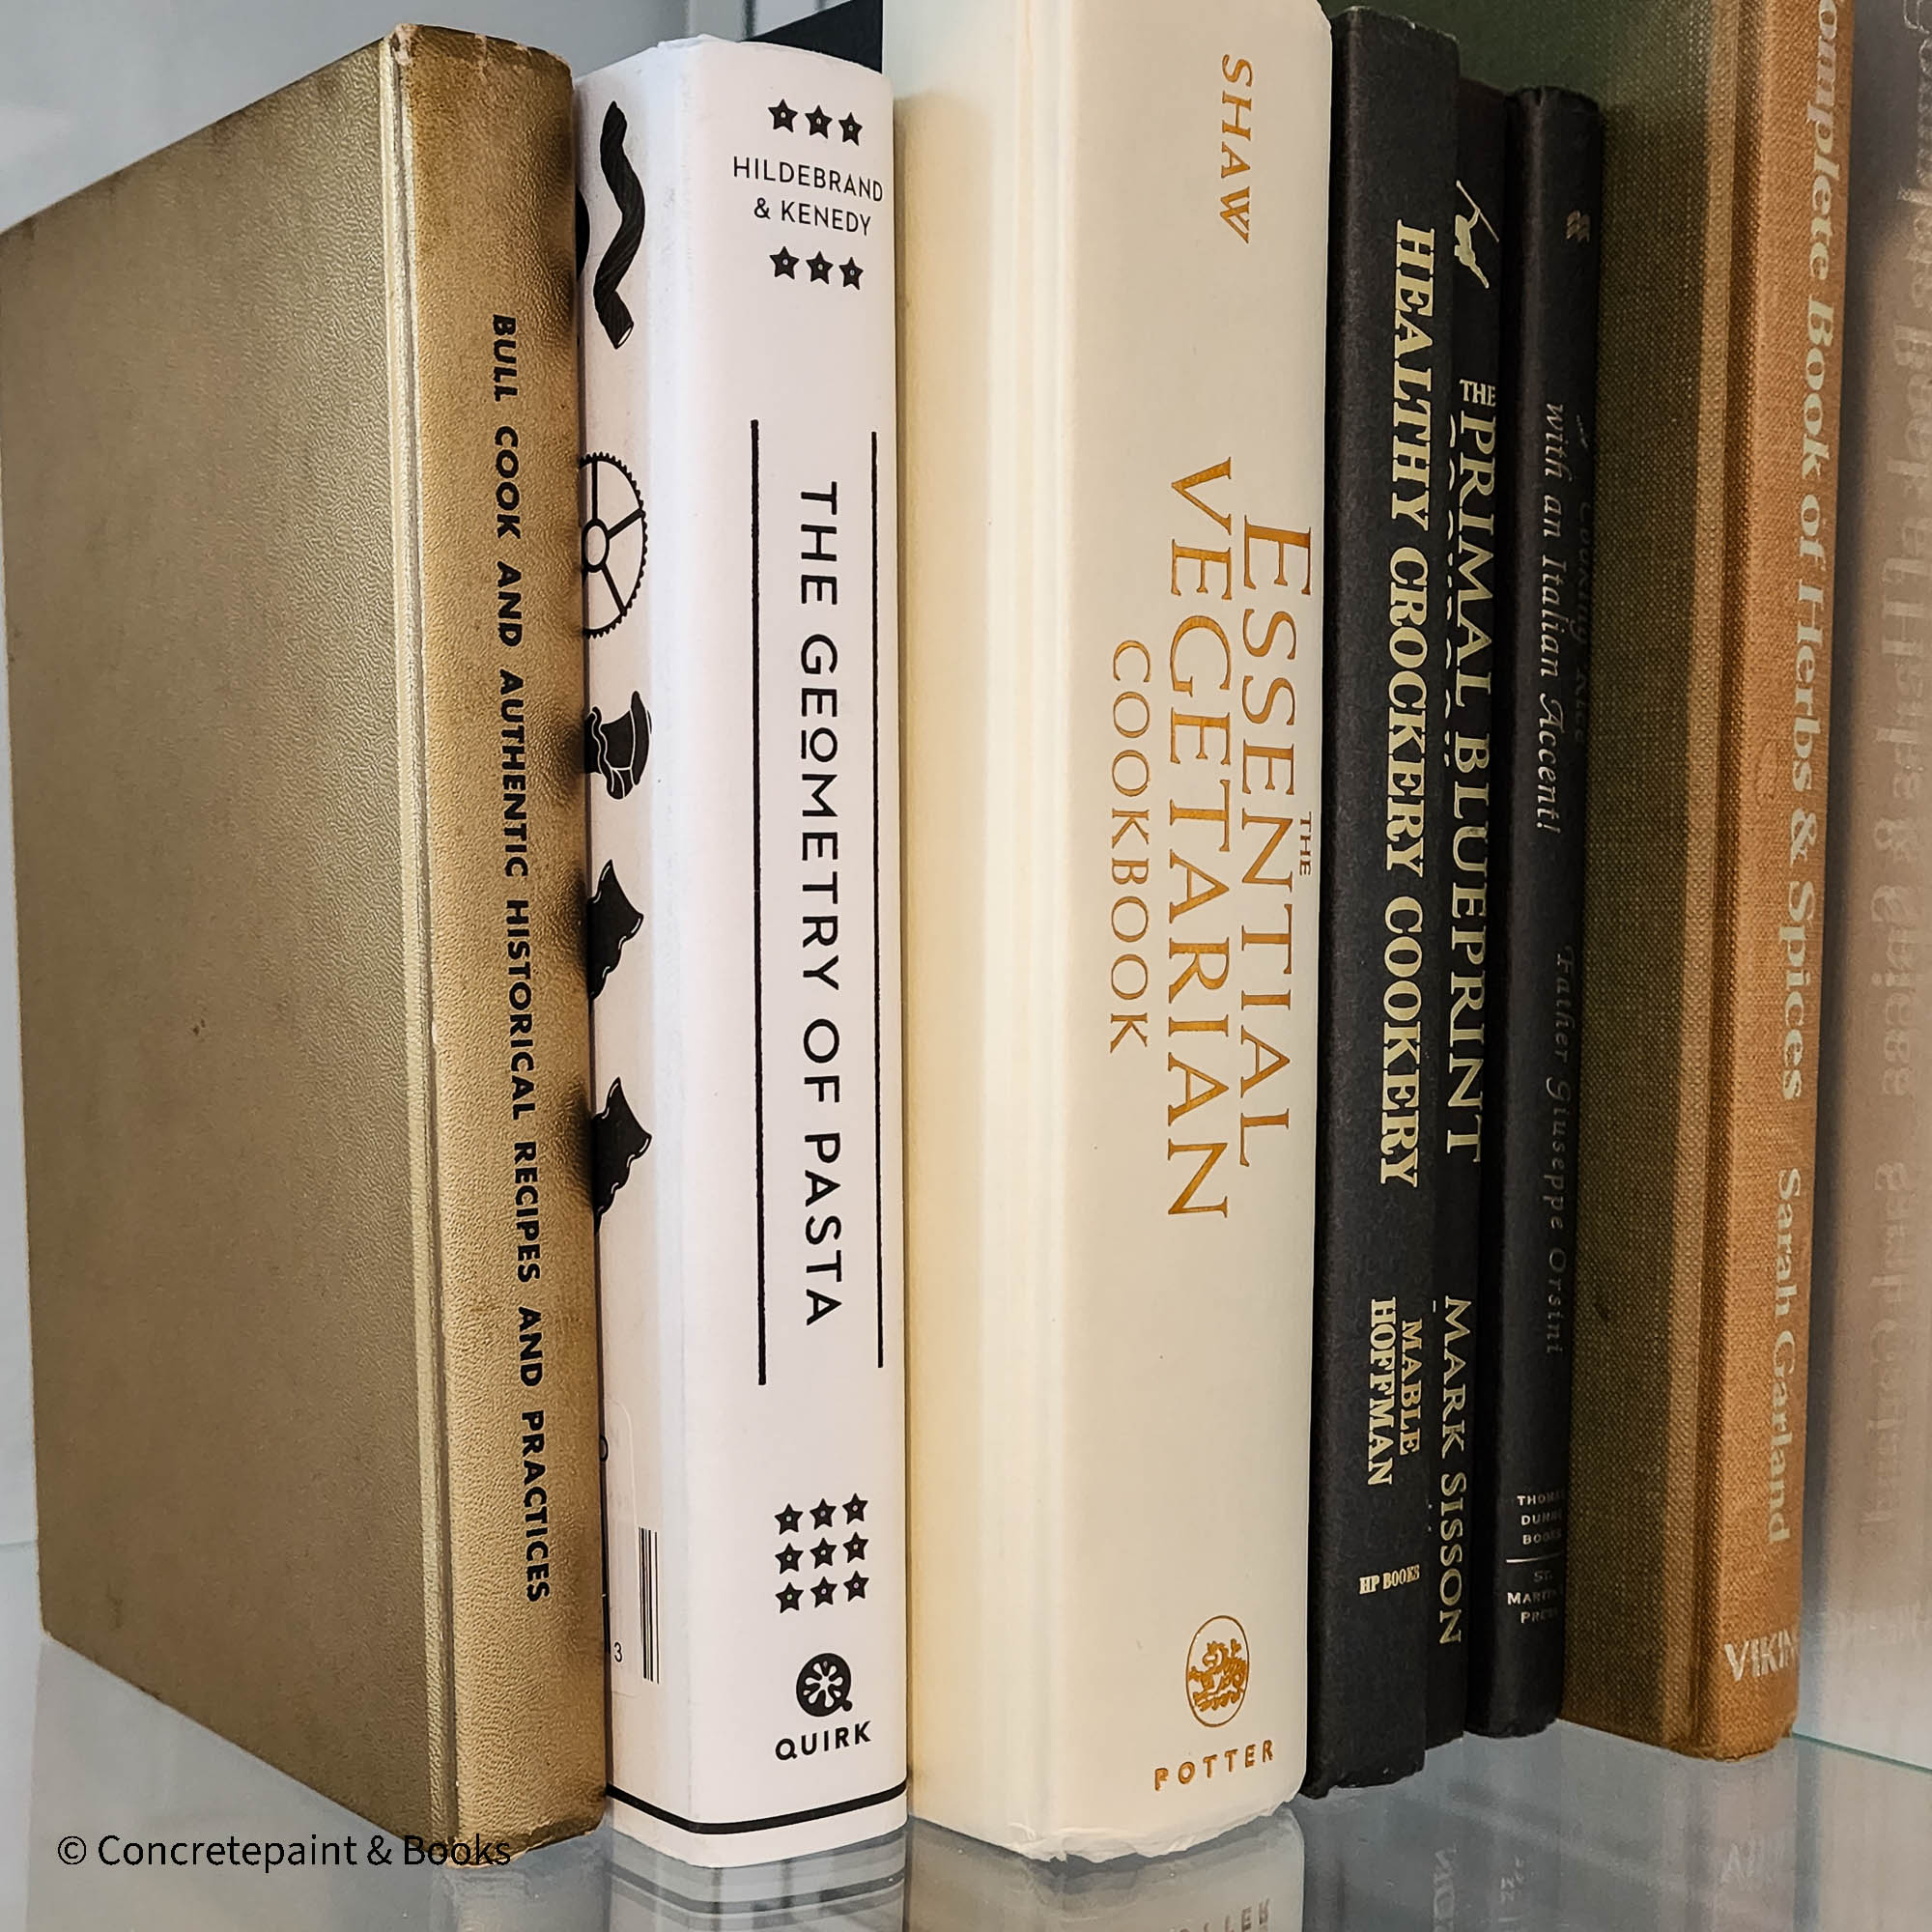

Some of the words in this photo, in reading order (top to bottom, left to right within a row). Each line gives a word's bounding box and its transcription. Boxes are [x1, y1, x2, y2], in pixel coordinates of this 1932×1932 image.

[732, 156, 884, 202] HILDEBRAND
[1220, 54, 1253, 242] SHAW
[1807, 0, 1840, 280] omplete
[753, 196, 771, 220] &
[781, 199, 871, 237] KENEDY
[492, 313, 519, 402] BULL
[1391, 218, 1435, 531] HEALTHY
[1459, 379, 1496, 407] THE
[1802, 298, 1833, 476] Book
[494, 425, 522, 540] COOK
[1545, 402, 1573, 482] with
[800, 480, 838, 606] THE
[1455, 410, 1496, 707] PRIMAL
[1543, 495, 1562, 537] an
[1799, 493, 1827, 572] of
[497, 560, 523, 647] AND
[1540, 554, 1567, 678] Italian
[1386, 547, 1429, 878] CROCKERY
[1792, 582, 1825, 792] Herbs
[498, 668, 528, 877] AUTHENTIC
[800, 633, 839, 991] GEOMETRY
[1536, 693, 1564, 834] Accent!
[1110, 639, 1151, 1054] COOKBOOK
[1166, 458, 1233, 1215] VEGETARIAN
[1239, 514, 1313, 1168] ESSENTIAL
[1299, 810, 1312, 876] THE
[1789, 808, 1817, 864] &
[505, 897, 536, 1121] HISTORICAL
[1447, 730, 1491, 1163] BLUEPRINT
[1553, 945, 1576, 1063] Father
[1779, 881, 1813, 1098] Spices
[803, 1018, 840, 1103] OF
[1379, 895, 1424, 1188] COOKERY
[514, 1141, 541, 1283] RECIPES
[1543, 1076, 1573, 1231] Giuseppe
[804, 1132, 842, 1326] PASTA
[1776, 1167, 1802, 1315] Sarah
[518, 1306, 544, 1387] AND
[1546, 1247, 1567, 1354] Orsini
[1367, 1296, 1397, 1486] HOFFMAN
[1399, 1319, 1423, 1456] MABLE
[1441, 1295, 1472, 1459] MARK
[1769, 1329, 1794, 1540] Garland
[521, 1409, 551, 1604] PRACTICES
[1439, 1473, 1466, 1644] SISSON
[1359, 1575, 1380, 1595] HP
[1382, 1564, 1420, 1590] BOOKS
[613, 1641, 623, 1663] 3
[1723, 1630, 1797, 1682] VIKIN
[775, 1720, 871, 1761] QUIRK
[1154, 1740, 1273, 1792] POTTER
